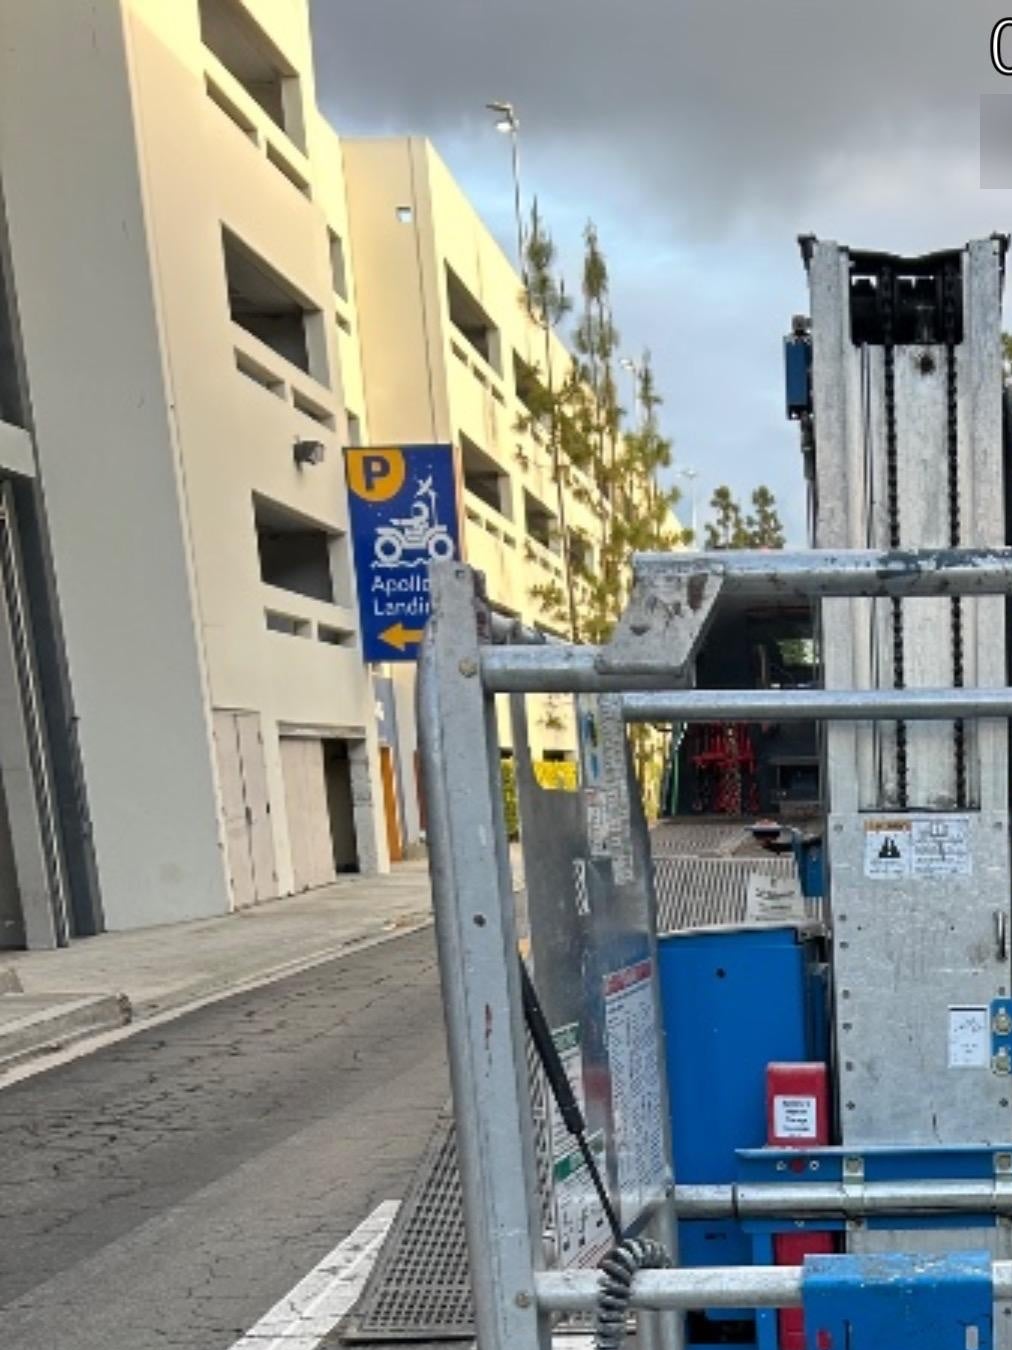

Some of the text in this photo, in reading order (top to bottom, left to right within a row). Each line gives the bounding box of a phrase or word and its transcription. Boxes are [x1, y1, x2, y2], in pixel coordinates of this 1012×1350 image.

[362, 455, 391, 491] P
[371, 574, 431, 597] Apollo
[373, 596, 430, 616] Landi
